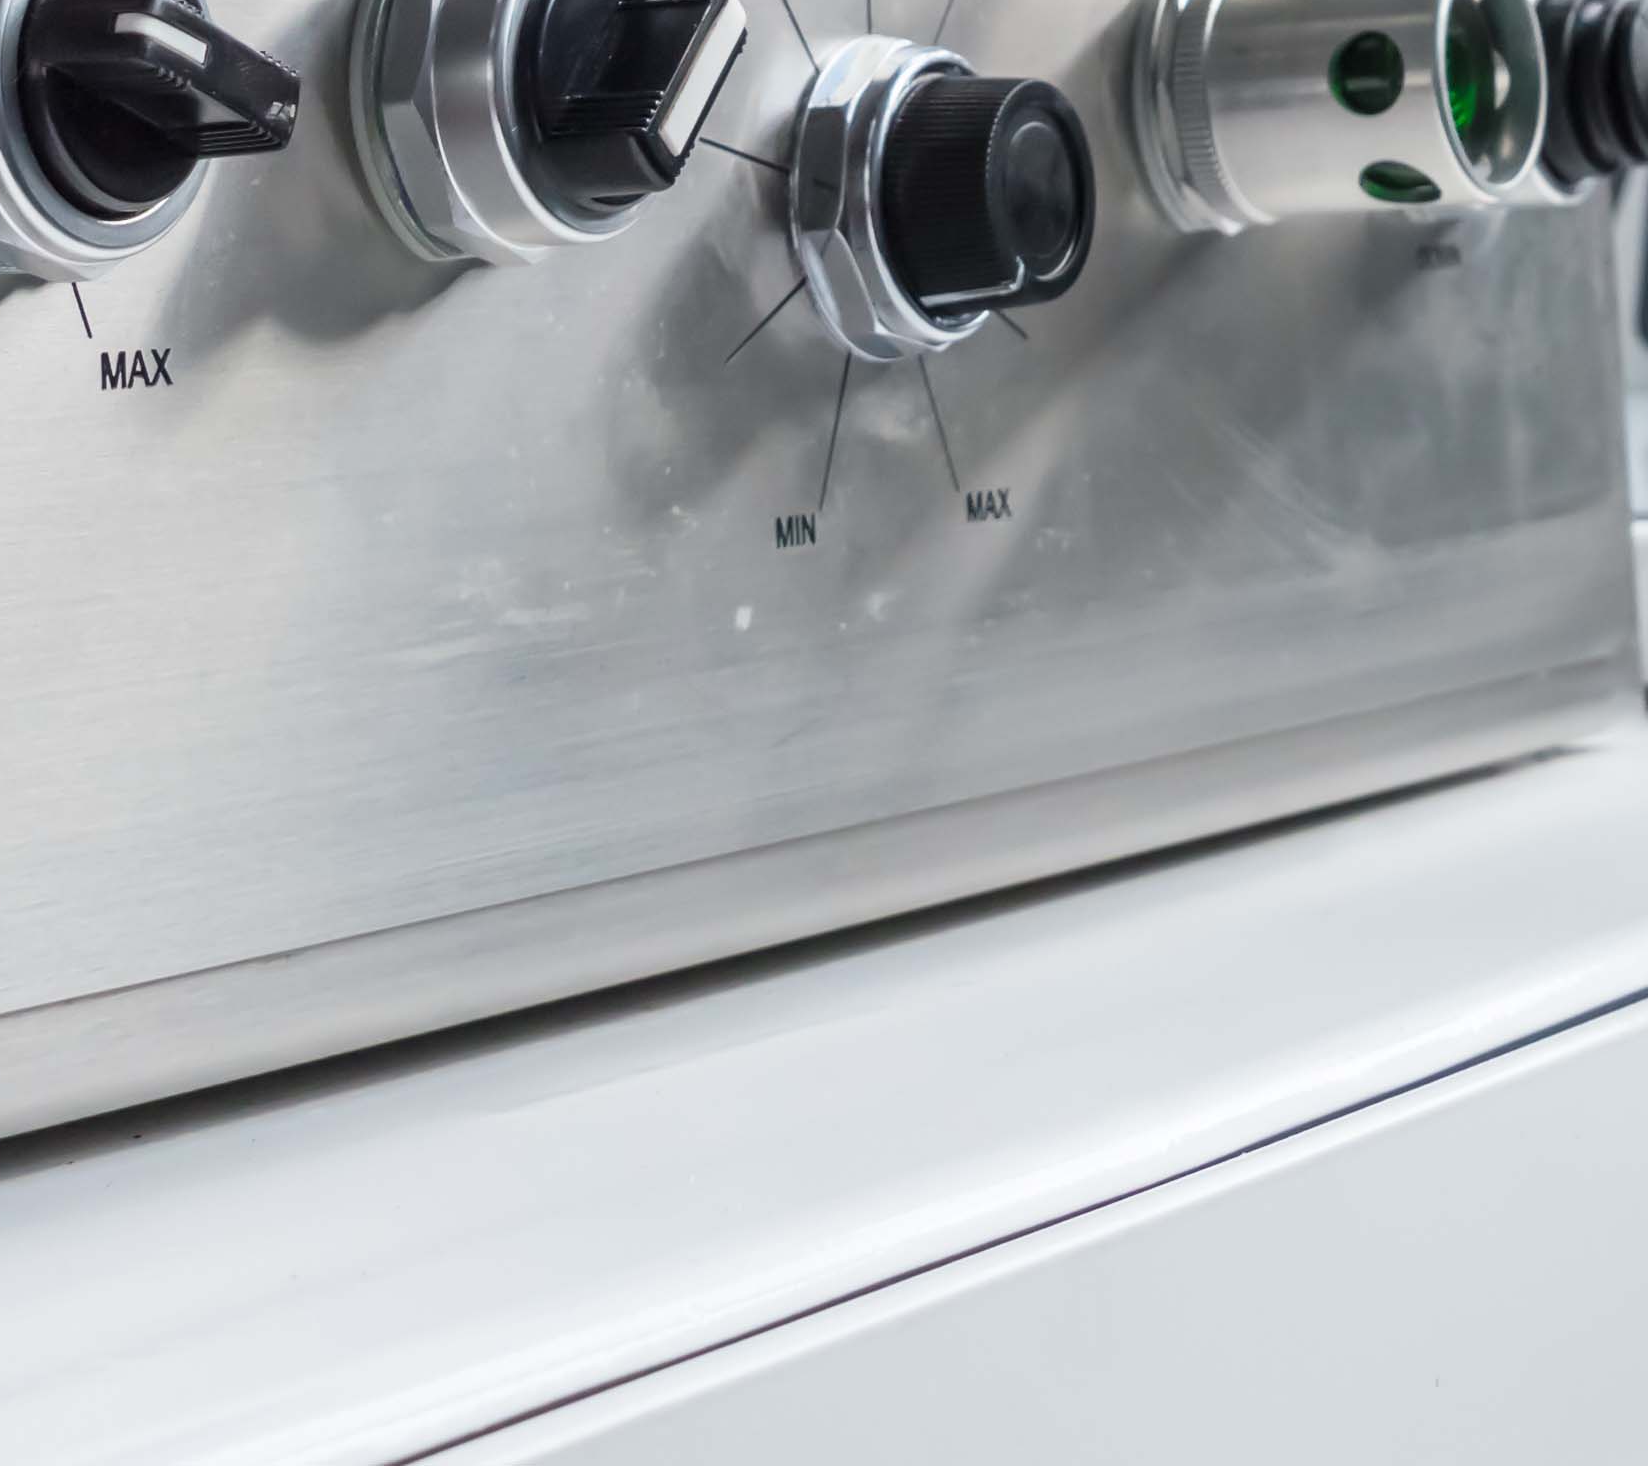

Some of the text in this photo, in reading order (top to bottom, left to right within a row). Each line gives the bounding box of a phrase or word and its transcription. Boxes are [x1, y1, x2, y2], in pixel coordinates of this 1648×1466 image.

[100, 347, 174, 391] MAX
[966, 487, 1013, 523] MAX
[775, 512, 817, 549] MIN
